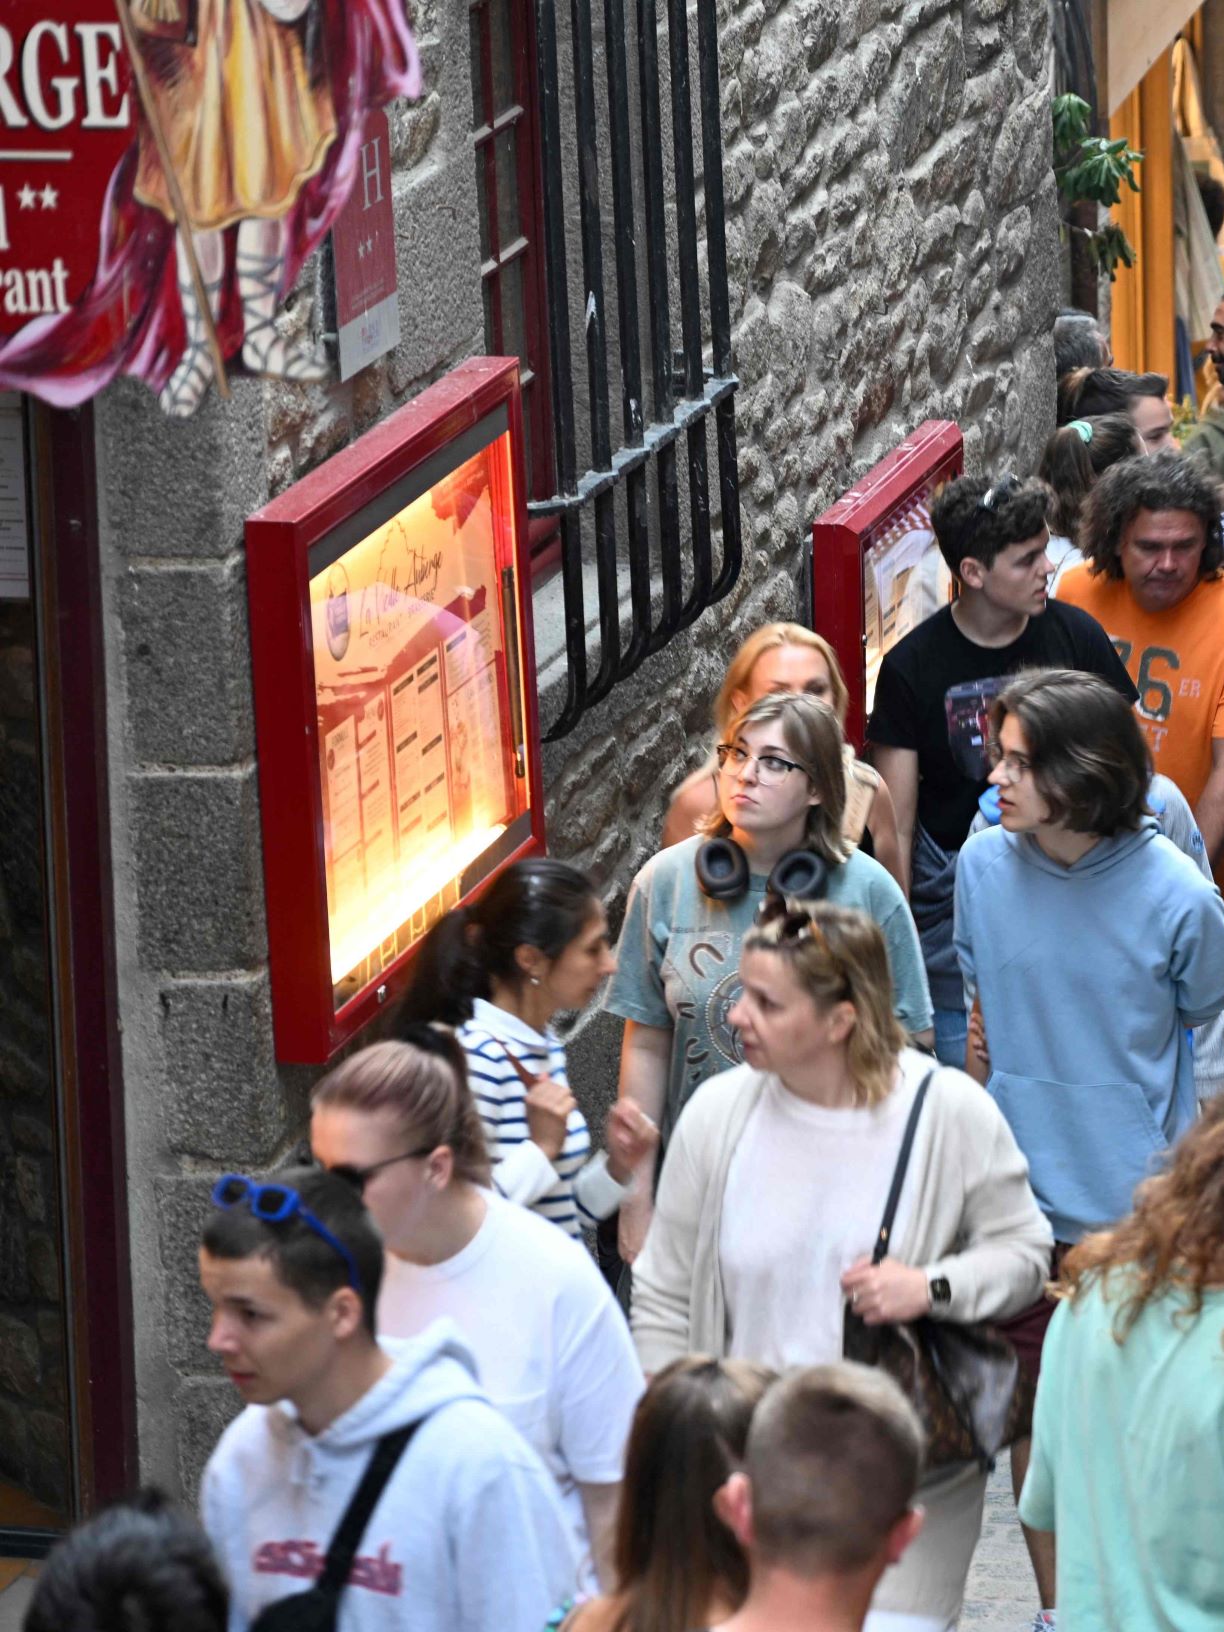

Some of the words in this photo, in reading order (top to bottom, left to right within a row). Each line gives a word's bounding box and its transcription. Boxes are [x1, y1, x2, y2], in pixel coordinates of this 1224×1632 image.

[360, 136, 385, 212] H
[0, 257, 72, 314] ant
[1178, 677, 1201, 698] ER
